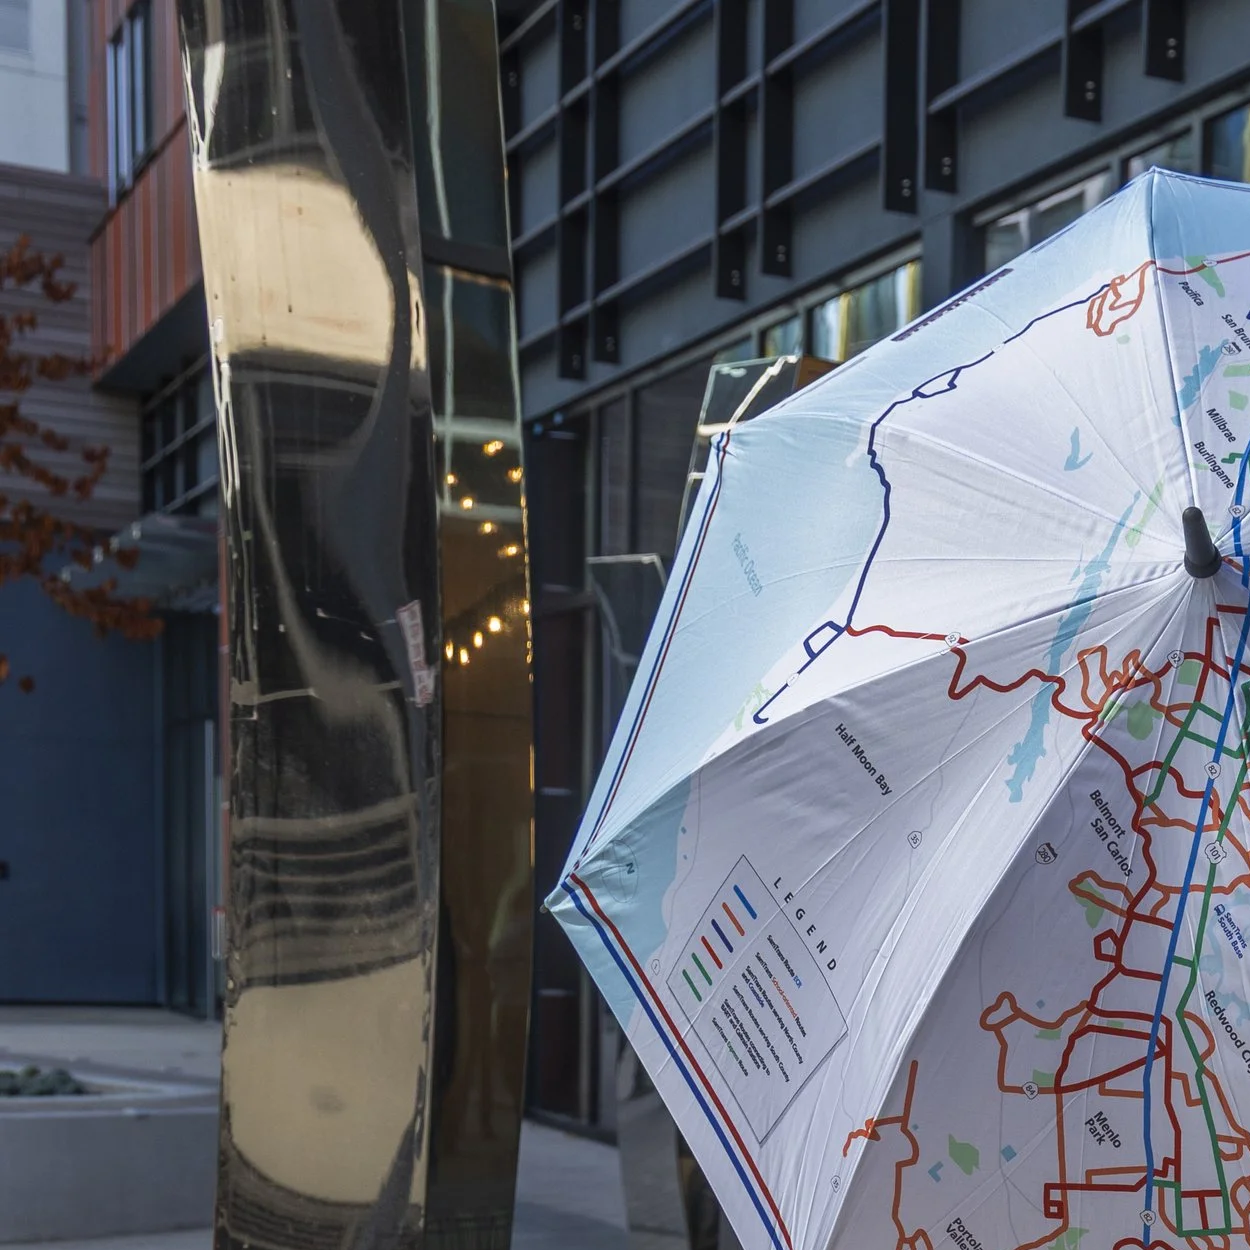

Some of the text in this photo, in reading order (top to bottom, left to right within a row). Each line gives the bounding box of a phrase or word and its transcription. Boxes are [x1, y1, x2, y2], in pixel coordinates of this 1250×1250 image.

[1178, 282, 1204, 306] Pacifica
[1222, 314, 1237, 328] San
[1206, 408, 1236, 443] Millbrae
[1194, 441, 1234, 489] Burlingame
[835, 723, 892, 796] Half Moon Bay
[1208, 765, 1217, 775] 82
[1090, 790, 1126, 839] Belmont
[910, 833, 920, 845] 35
[1038, 846, 1051, 863] 280
[1090, 818, 1133, 878] San Carlos
[1209, 846, 1221, 861] 101
[626, 863, 635, 874] N
[773, 877, 837, 971] LEGEND
[1218, 916, 1243, 959] South Base
[1224, 912, 1247, 949] SamTrans
[767, 935, 785, 961] SamTrans
[782, 959, 794, 977] Route
[742, 973, 750, 983] and
[755, 952, 773, 978] SamTrans
[795, 1017, 806, 1037] Routes
[724, 999, 740, 1024] SamTrans
[737, 1022, 750, 1041] Routes
[732, 985, 749, 1010] SamTrans
[747, 1009, 760, 1028] Routes
[768, 1046, 779, 1063] South
[779, 1062, 789, 1082] County
[746, 966, 763, 992] SamTrans
[760, 990, 774, 1009] Routes
[782, 1027, 793, 1044] North
[792, 1043, 803, 1064] County
[1205, 990, 1245, 1049] Redwood
[712, 1018, 728, 1042] SamTrans
[737, 1060, 748, 1076] Route
[1025, 1084, 1036, 1096] 84
[1084, 1118, 1107, 1146] Park
[1093, 1111, 1122, 1148] Menlo
[1143, 1212, 1152, 1223] 82
